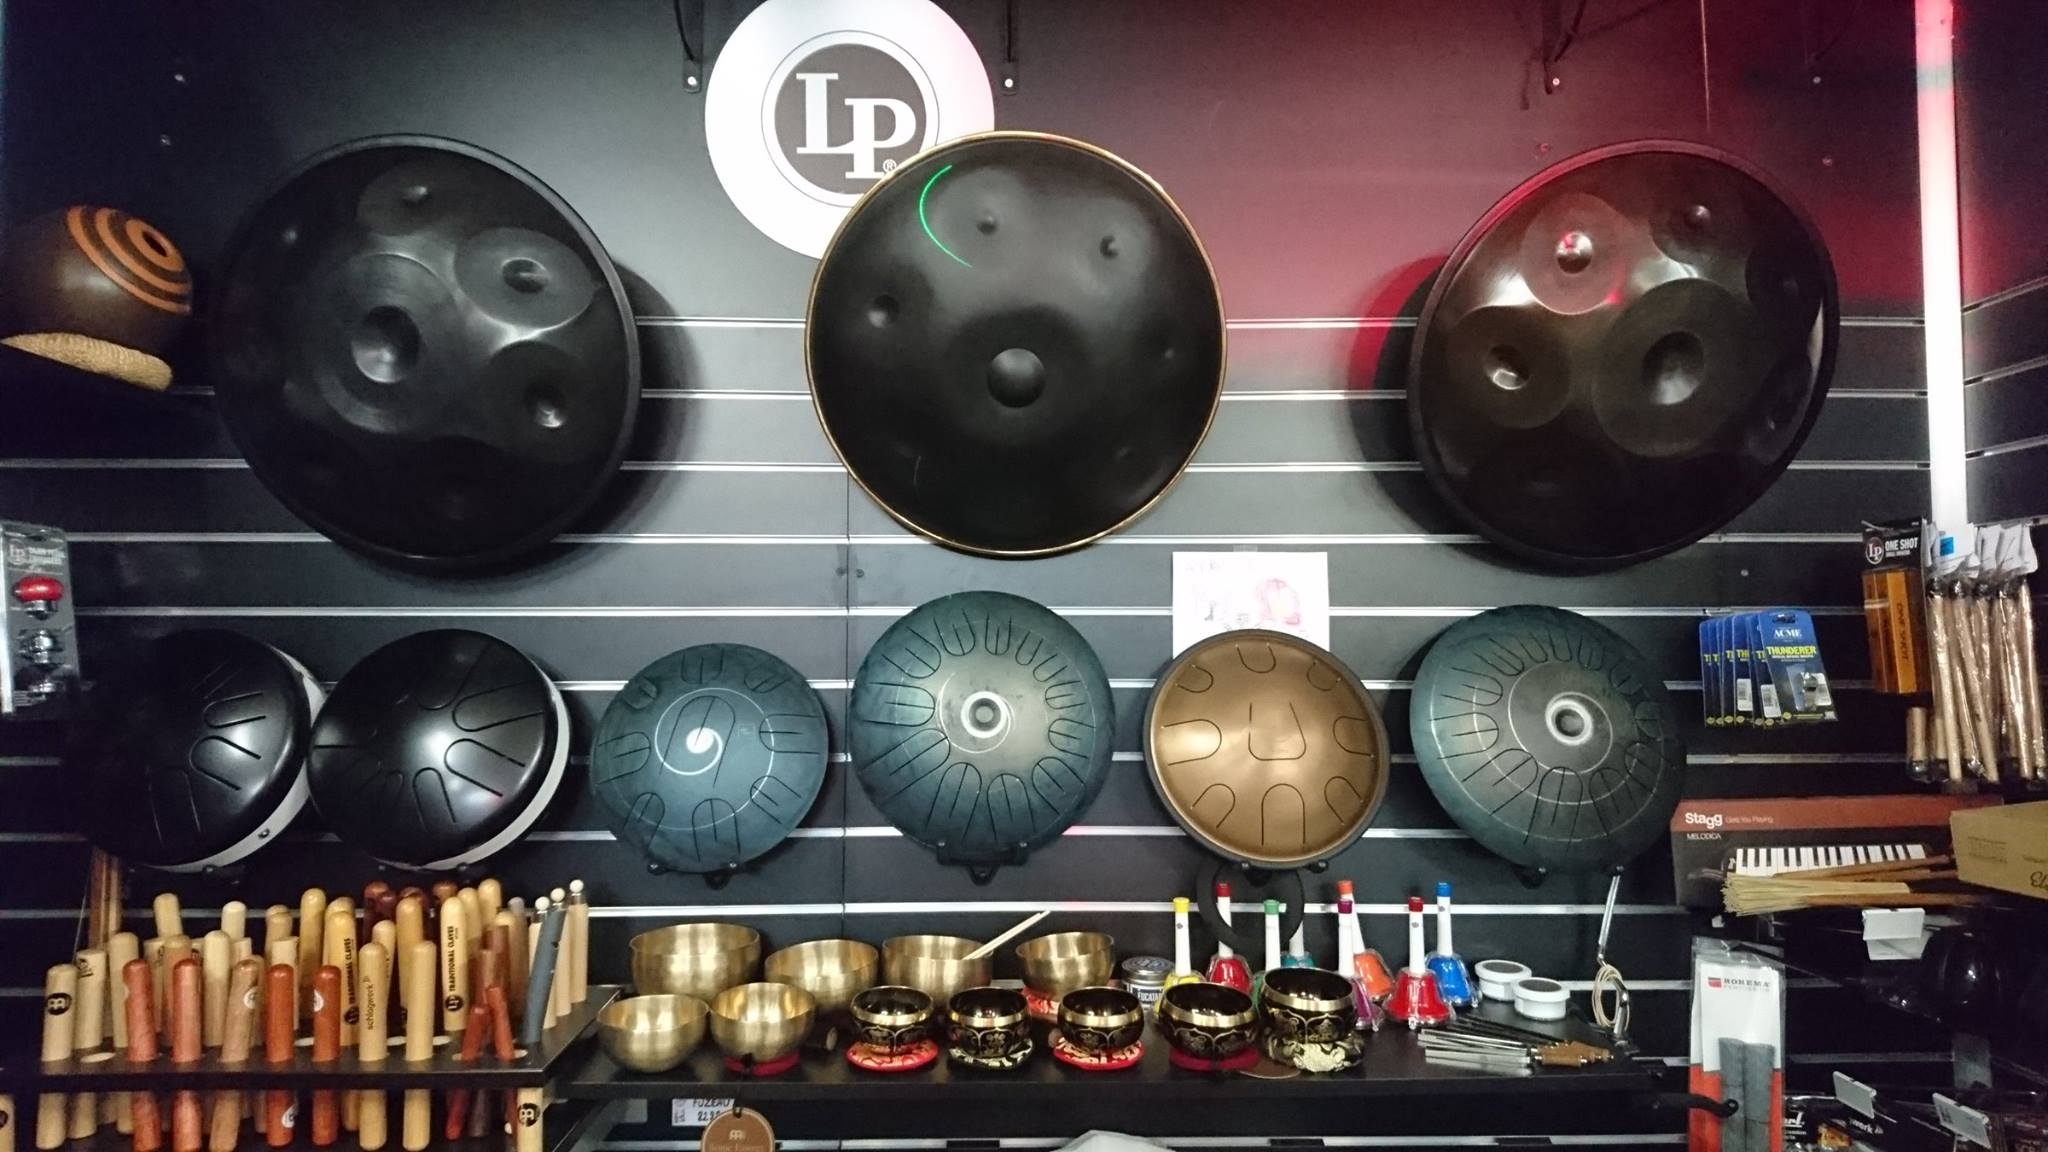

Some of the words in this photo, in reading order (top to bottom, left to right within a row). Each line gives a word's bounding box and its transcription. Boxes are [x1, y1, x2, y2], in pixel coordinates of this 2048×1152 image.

[1868, 543, 1883, 561] LP
[1884, 540, 1899, 552] ONE
[1900, 537, 1919, 549] SHOT
[1774, 628, 1803, 639] ACME
[1765, 645, 1817, 656] THUNDERER
[1684, 812, 1723, 830] Stagg
[1686, 832, 1722, 841] MELODICA
[447, 926, 455, 949] CLAVES
[448, 950, 456, 992] TRADITIONAL
[1723, 977, 1771, 988] ROHEMA
[366, 983, 376, 1030] schlagwerk
